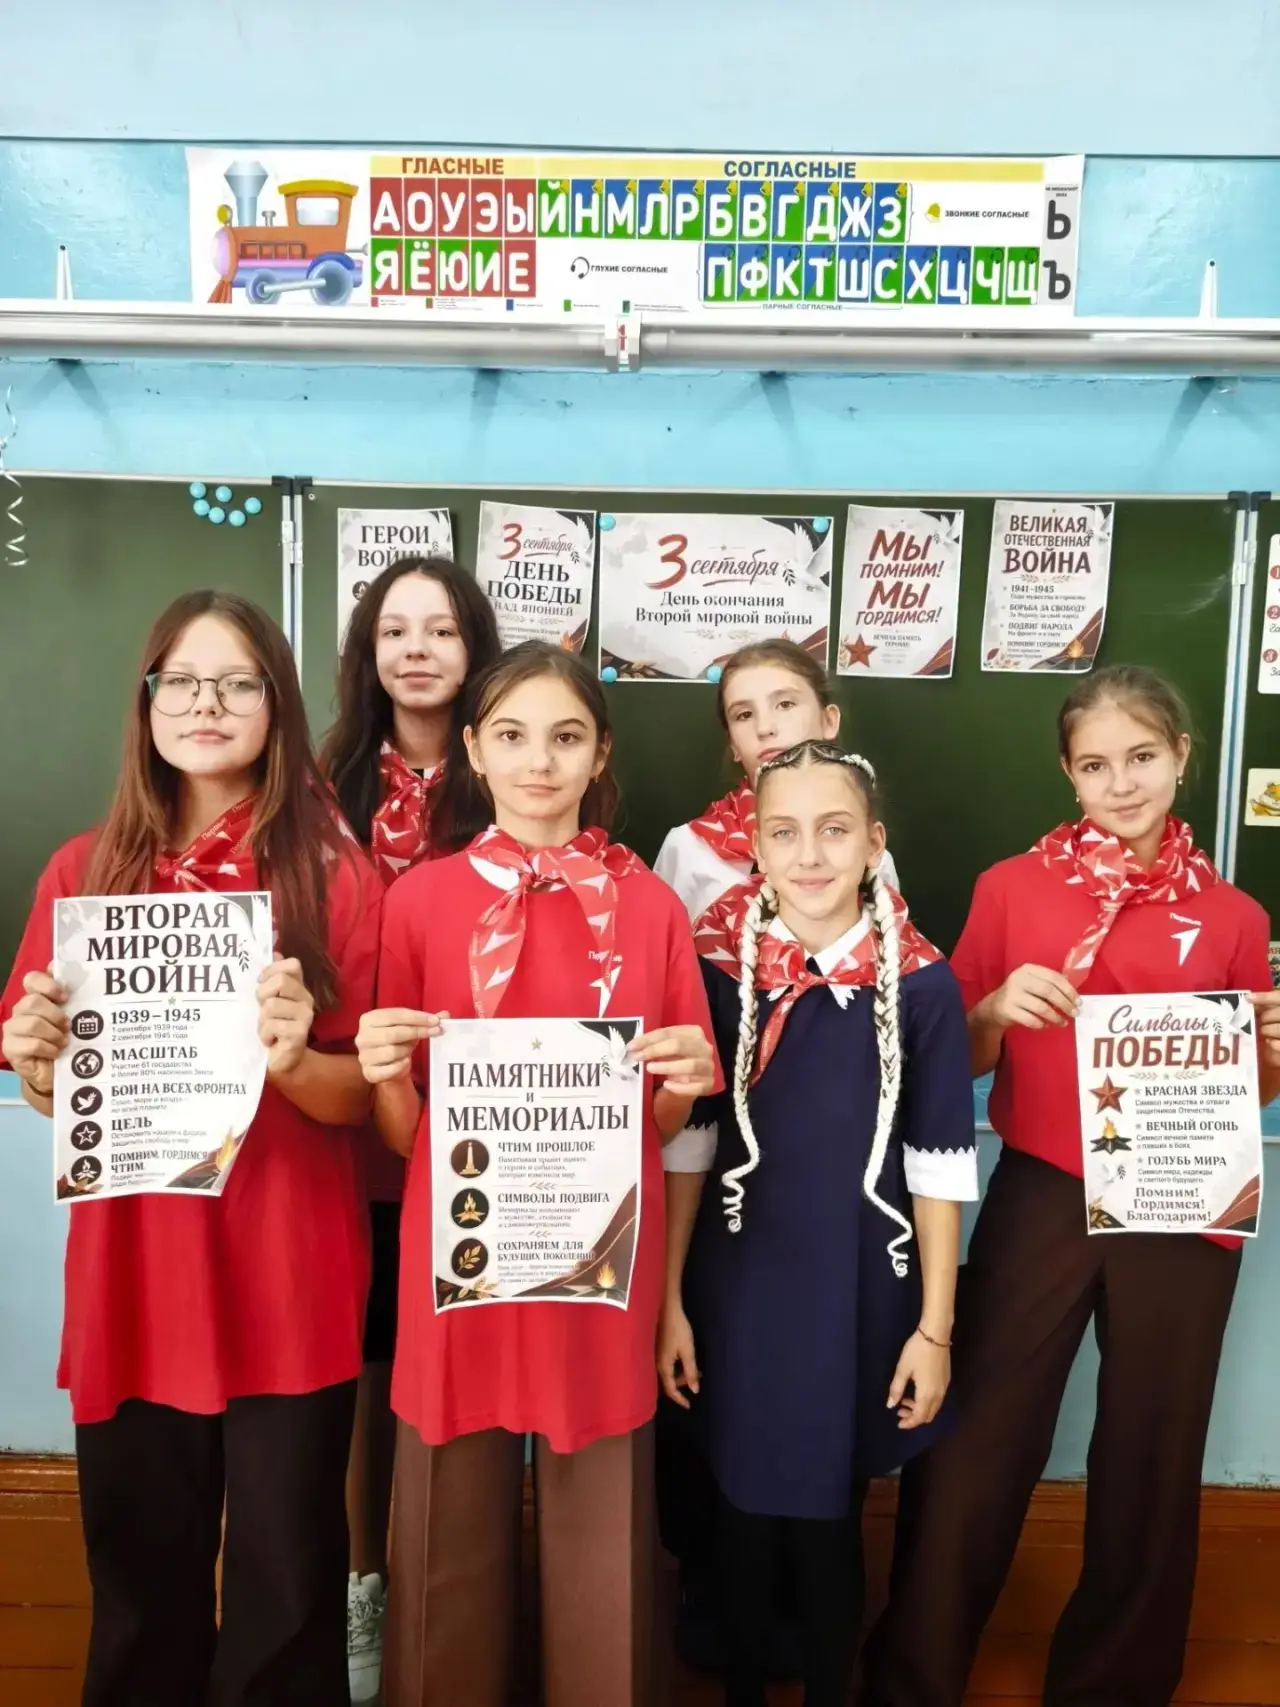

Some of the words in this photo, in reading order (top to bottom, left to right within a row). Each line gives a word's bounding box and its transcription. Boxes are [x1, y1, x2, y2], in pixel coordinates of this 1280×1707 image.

[401, 157, 505, 176] ГЛАСНЫЕ
[723, 160, 857, 179] СОГЛАСНЫЕ
[945, 209, 979, 218] ЗВОНКИЕ
[981, 210, 1030, 219] СОГЛАСНЫЕ
[591, 264, 620, 273] ГЛУХИЕ
[621, 265, 668, 274] СОГЛАСНЫЕ
[796, 303, 843, 311] СОГЛАСНЫЕ
[1009, 515, 1088, 533] ВЕЛИКАЯ
[361, 525, 430, 544] ГЕРОИ
[498, 523, 522, 560] 3
[523, 534, 576, 554] сентября
[1004, 533, 1092, 547] ОТЕЧЕСТВЕННАЯ
[645, 533, 688, 590] 3
[690, 549, 779, 585] сентября
[860, 560, 945, 578] ПОМНИМ!
[1003, 548, 1092, 574] ВОЙНА
[504, 560, 569, 582] ДЕНЬ
[487, 580, 582, 605] ПОБЕДЫ
[660, 591, 700, 607] День
[703, 596, 785, 608] окончания
[494, 602, 517, 613] НАД
[521, 604, 573, 616] ЯПОНИЕЙ
[856, 607, 942, 626] ГОРДИМСЯ!
[635, 607, 691, 628] Второй
[696, 610, 760, 628] мировой
[764, 611, 813, 625] войны
[1008, 622, 1038, 630] ПОДВИГ
[1041, 623, 1073, 631] НАРОДА
[104, 902, 230, 932] ВТОРАЯ
[87, 933, 239, 962] МИРОВАЯ
[104, 959, 236, 996] ВОЙНА
[153, 1023, 171, 1031] 1939
[1108, 1004, 1209, 1034] Символы
[111, 1046, 198, 1061] МАСШТАБ
[1092, 1034, 1240, 1070] ПОБЕДЫ
[448, 1063, 601, 1088] ПАМЯТНИКИ
[111, 1084, 138, 1097] БОИ
[141, 1083, 160, 1095] НА
[162, 1082, 192, 1094] ВСЕХ
[193, 1082, 247, 1095] ФРОНТАХ
[1145, 1085, 1198, 1097] КРАСНАЯ
[1200, 1085, 1248, 1096] ЗВЕЗДА
[111, 1116, 152, 1132] ЦЕЛЬ
[447, 1104, 630, 1132] МЕМОРИАЛЫ
[1146, 1119, 1196, 1131] ВЕЧНЫЙ
[1199, 1121, 1239, 1131] ОГОНЬ
[498, 1142, 531, 1153] ЧТИМ
[536, 1141, 596, 1152] ПРОШЛОЕ
[111, 1162, 144, 1173] ЧТИМ
[1147, 1156, 1191, 1166] ГОЛУБЬ
[1194, 1156, 1227, 1166] МИРА
[498, 1193, 555, 1204] СИМВОЛЫ
[560, 1193, 610, 1204] ПОДВИГА
[1135, 1187, 1199, 1198] Помним!
[1133, 1198, 1205, 1210] Гордимся!
[1126, 1210, 1212, 1223] Благодарим!
[497, 1241, 559, 1251] СОХРАНЯЕМ
[562, 1241, 584, 1250] ДЛЯ
[498, 1253, 541, 1262] БУДУЩИХ
